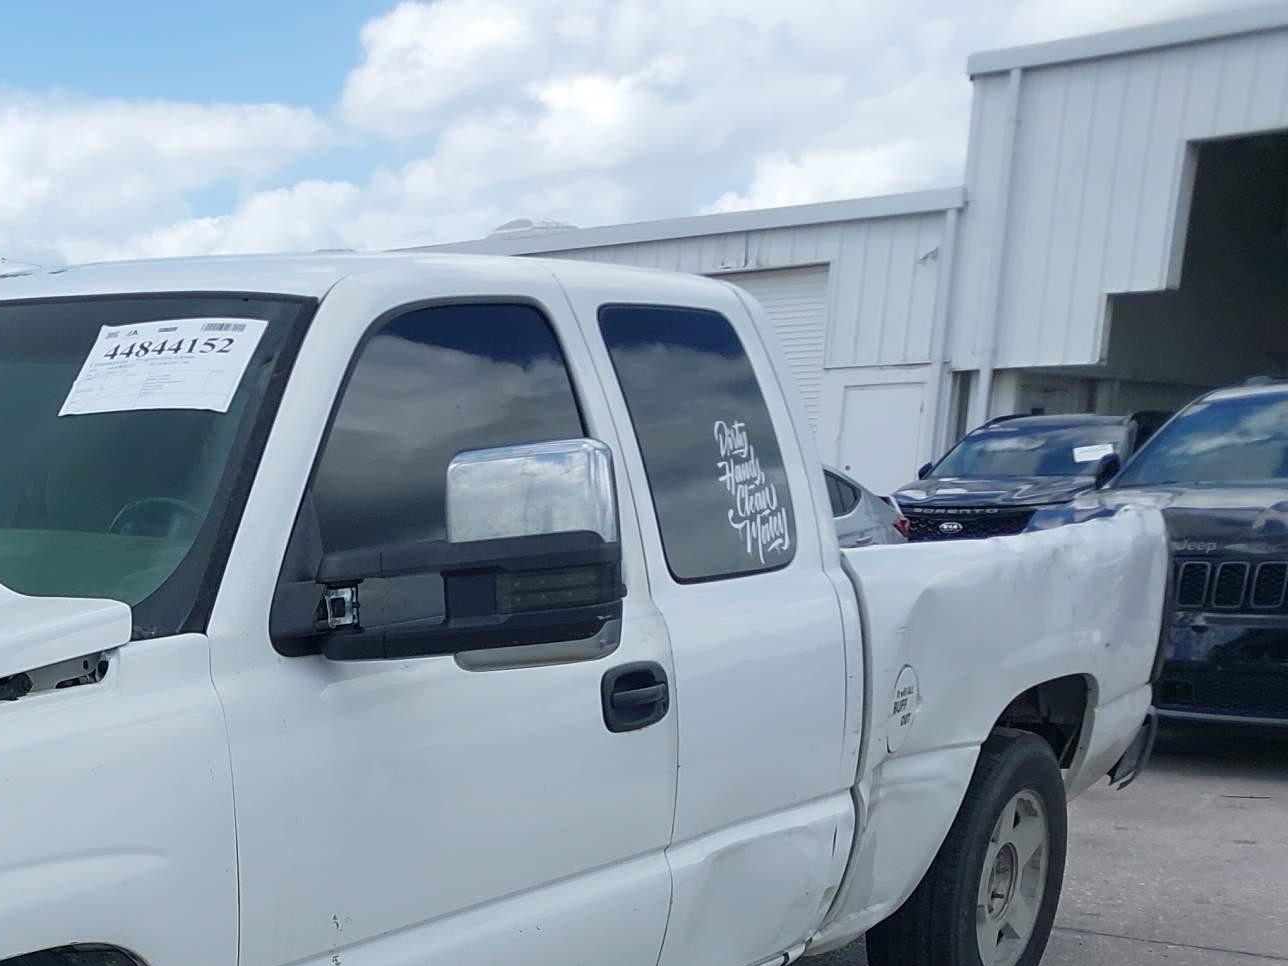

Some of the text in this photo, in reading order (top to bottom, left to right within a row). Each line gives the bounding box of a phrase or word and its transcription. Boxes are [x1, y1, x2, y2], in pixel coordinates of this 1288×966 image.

[104, 336, 235, 360] 44844152
[714, 420, 749, 458] Dirty
[737, 482, 778, 517] Clean
[912, 507, 999, 515] SORENTO
[728, 507, 790, 564] Money
[1175, 538, 1217, 554] Jeep
[892, 698, 908, 715] BUFF
[900, 712, 912, 727] OUT
